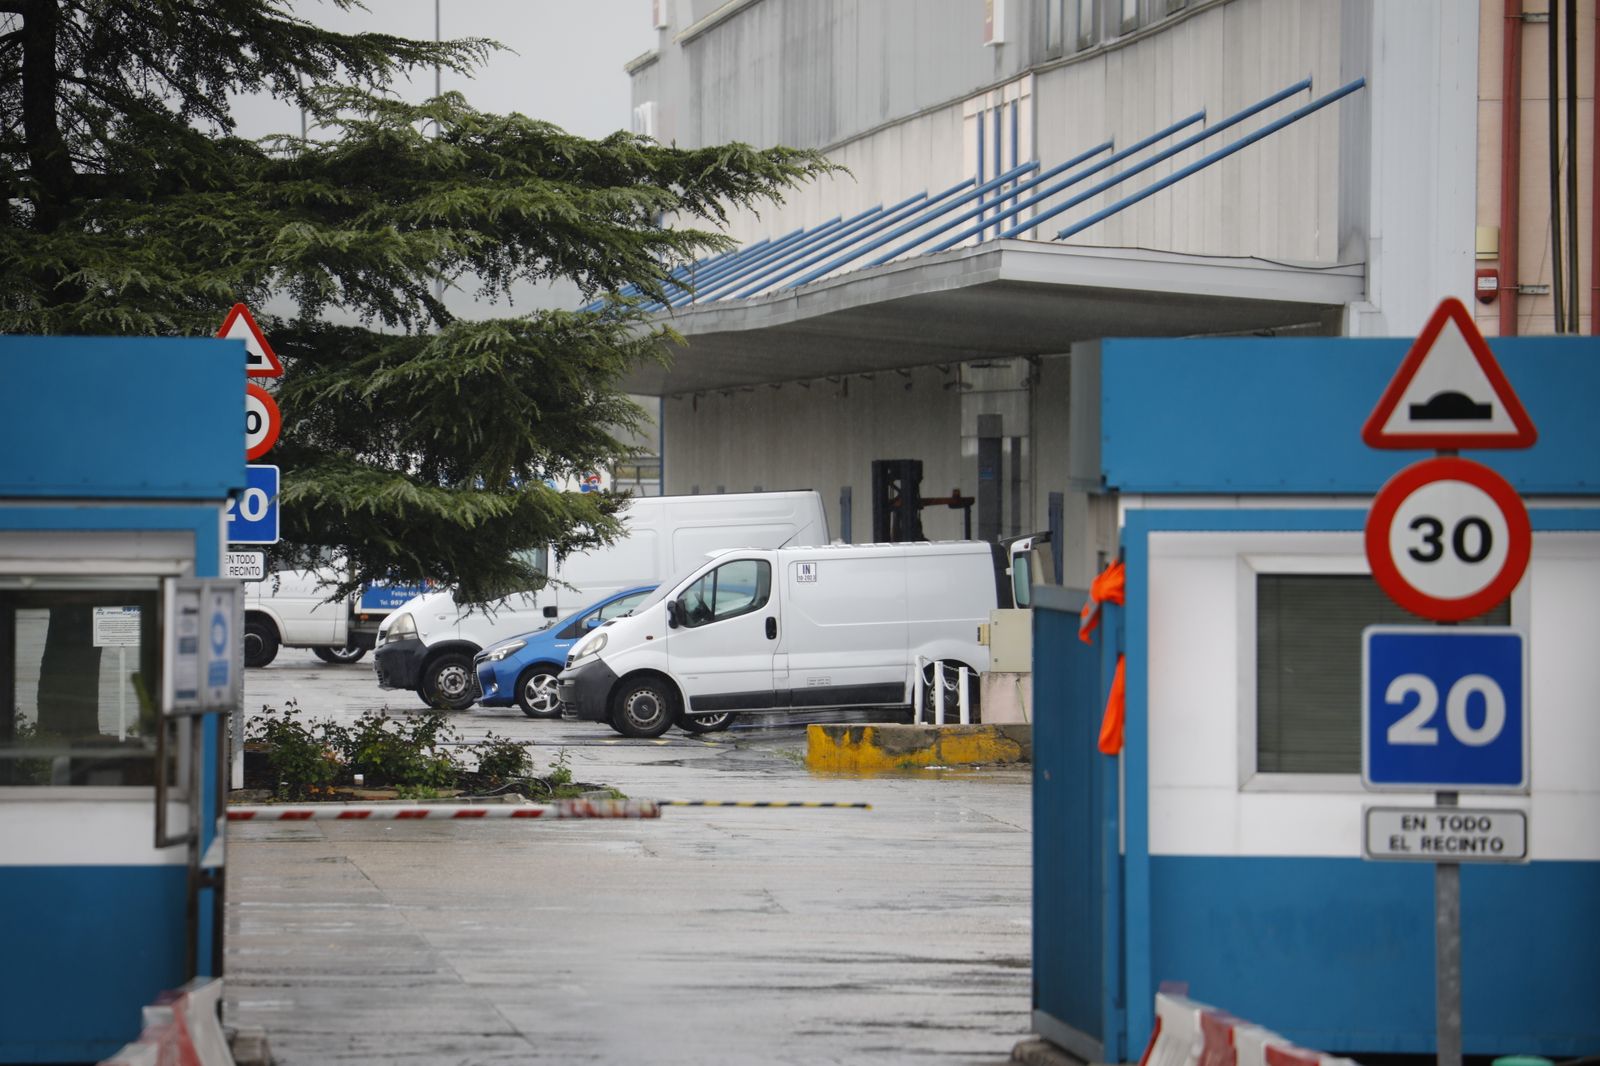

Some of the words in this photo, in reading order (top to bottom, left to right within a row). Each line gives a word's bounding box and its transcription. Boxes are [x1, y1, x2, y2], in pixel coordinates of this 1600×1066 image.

[246, 410, 262, 434] 0
[1408, 515, 1493, 564] 30
[236, 555, 256, 564] TODO
[230, 567, 260, 576] RECINTO
[802, 565, 811, 574] IN
[1385, 673, 1507, 747] 20
[1401, 815, 1427, 831] EN
[1436, 815, 1492, 831] TODO
[1389, 835, 1411, 851] EL
[1420, 835, 1504, 852] RECINTO
